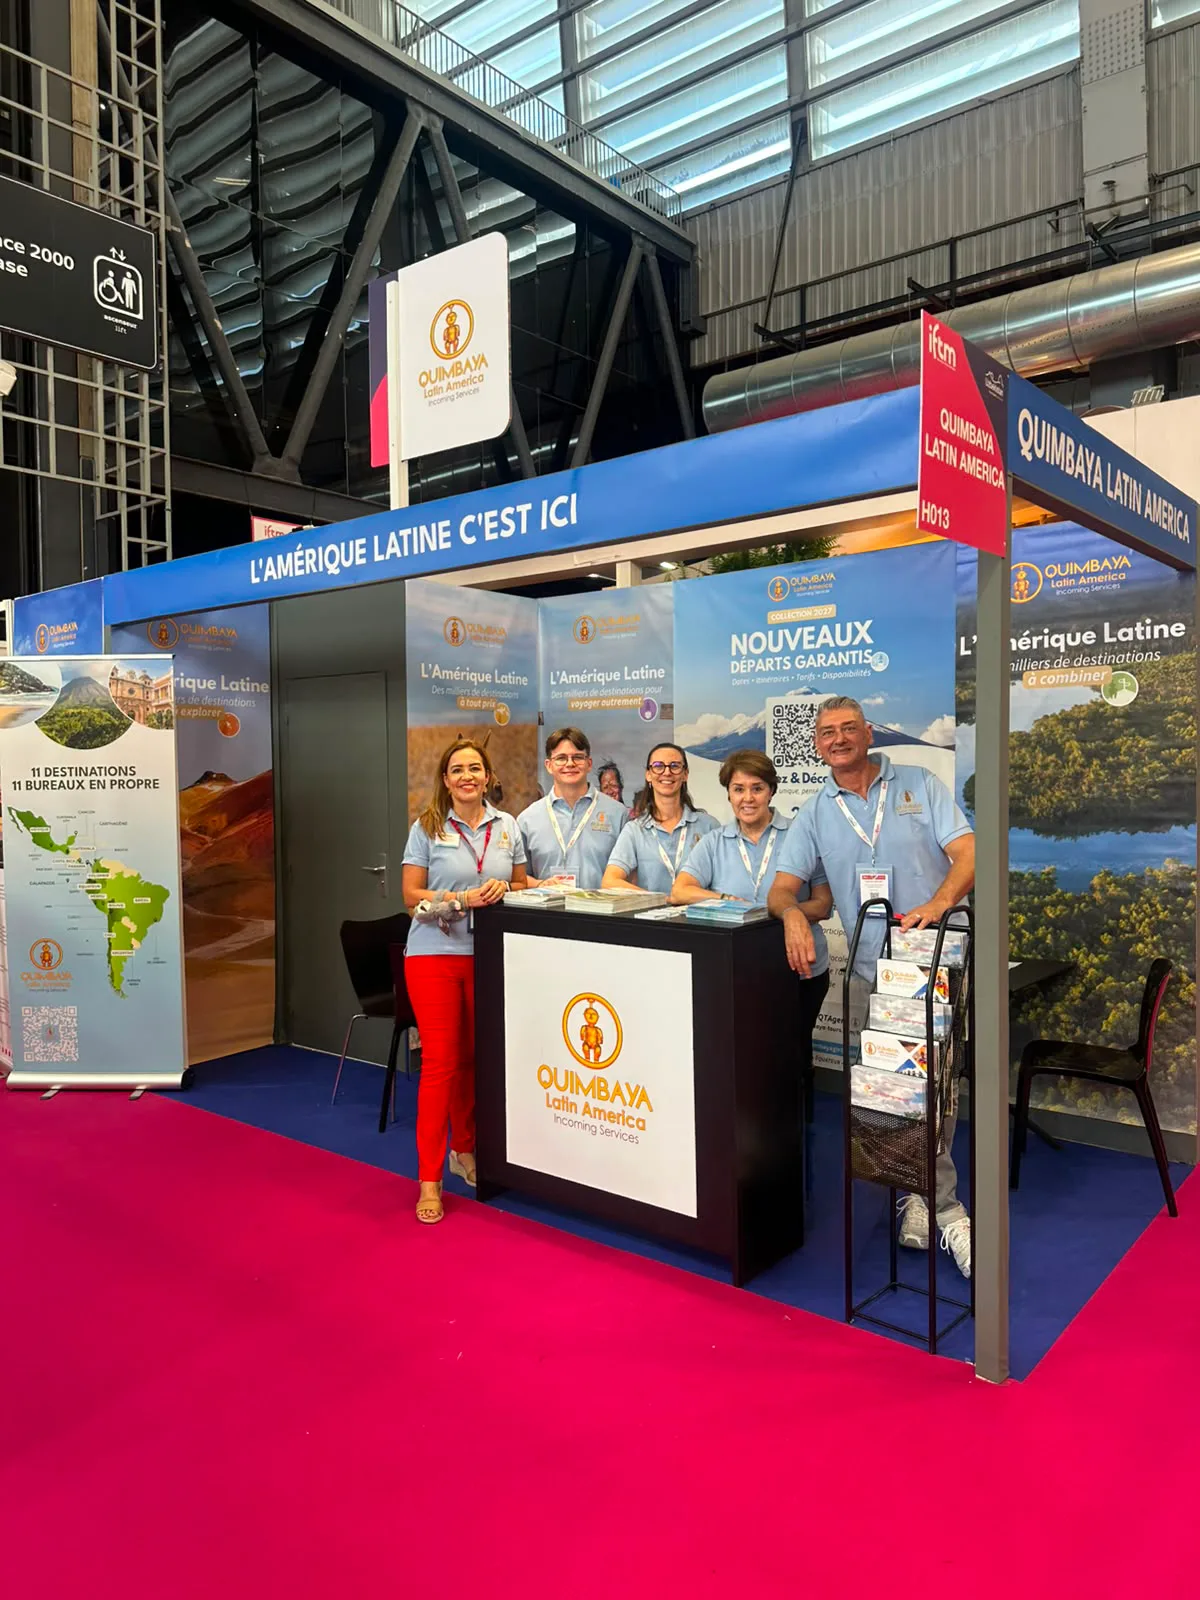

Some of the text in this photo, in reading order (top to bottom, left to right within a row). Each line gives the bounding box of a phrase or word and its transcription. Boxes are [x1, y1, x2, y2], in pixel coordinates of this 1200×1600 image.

[0, 237, 75, 270] ce 2000
[929, 323, 956, 368] iftm
[418, 352, 488, 388] QUIMBAYA
[424, 373, 485, 399] Latin America
[940, 408, 994, 456] QUIMBAYA
[925, 434, 1005, 490] LATIN AMERICA
[1018, 408, 1190, 543] QUIMBAYA LATIN AMERICA
[922, 500, 950, 529] H013
[251, 493, 577, 584] L'AMÉRIQUE LATINE C'EST ICI
[790, 572, 836, 586] QUIMBAYA
[1045, 555, 1132, 580] QUIMBAYA
[1051, 571, 1126, 589] Latin America
[1055, 582, 1121, 596] Incoming Services
[771, 607, 833, 621] COLLECTION 2027
[731, 619, 874, 656] NOUVEAUX
[1103, 618, 1187, 644] Latine
[731, 649, 873, 674] DÉPARTS GARANTIS
[1053, 654, 1071, 668] de
[1073, 649, 1161, 667] destinations
[221, 675, 269, 693] Latine
[420, 662, 528, 686] L'Amérique Latine
[550, 664, 665, 687] L'Amérique Latine
[731, 677, 750, 686] Dates
[796, 673, 816, 683] Tarifs
[822, 669, 872, 680] Disponibilités
[1028, 669, 1108, 686] à combiner
[201, 695, 256, 707] destinations
[431, 685, 444, 695] Des
[551, 689, 563, 699] Des
[589, 688, 599, 697] de
[599, 685, 644, 697] destinations
[644, 685, 662, 696] pour
[181, 706, 222, 719] explorer
[466, 699, 481, 708] tout
[570, 698, 600, 710] voyager
[31, 765, 136, 778] 11 DESTINATIONS
[12, 779, 160, 791] 11 BUREAUX EN PROPRE
[537, 1064, 653, 1112] QUIMBAYA
[546, 1092, 646, 1131] Latin America
[553, 1113, 640, 1144] Incoming Services
